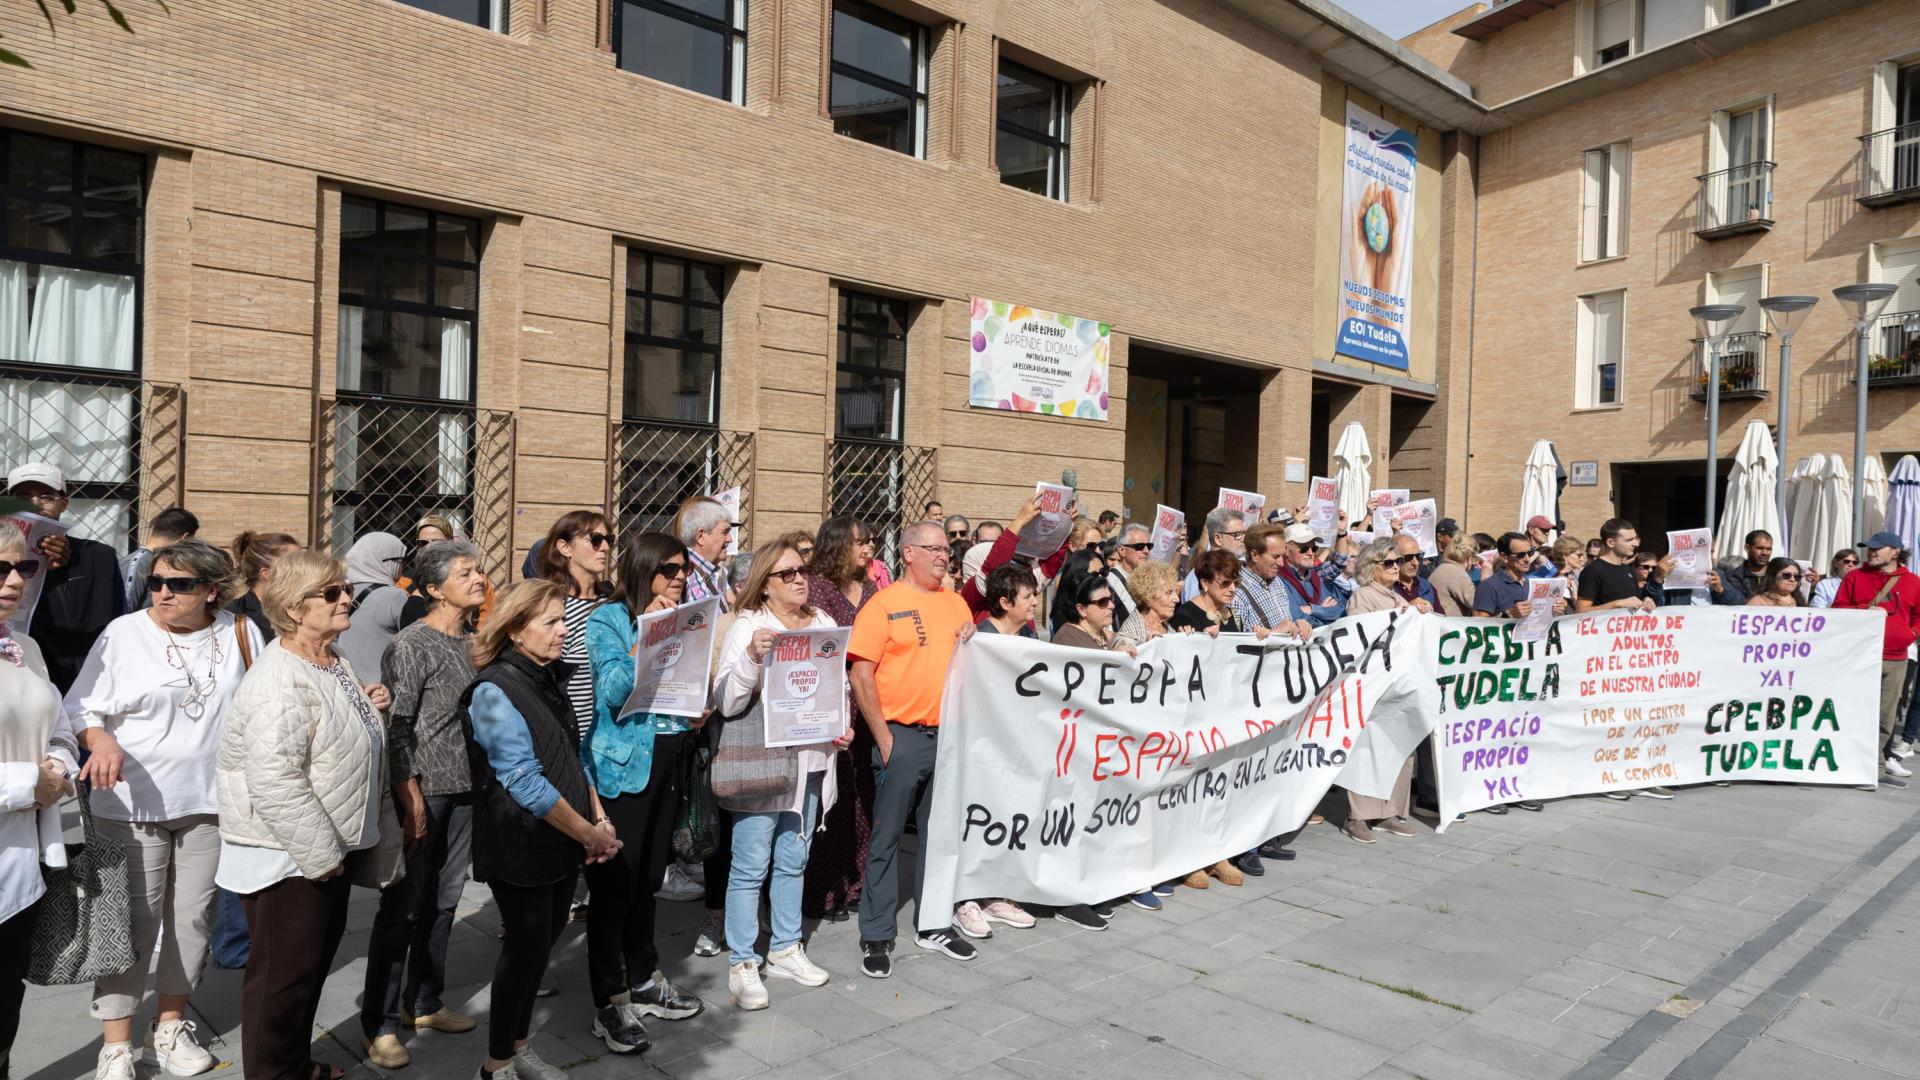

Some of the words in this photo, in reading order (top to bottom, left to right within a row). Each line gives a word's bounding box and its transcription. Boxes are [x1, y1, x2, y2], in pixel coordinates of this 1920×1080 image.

[1344, 280, 1372, 297] NUEVOS
[1372, 288, 1404, 307] IDIOMAS
[1346, 298, 1374, 314] NUEVOS
[1375, 307, 1404, 323] MUNDOS
[1350, 320, 1365, 336] EOI
[1368, 325, 1397, 344] Tudela
[1004, 333, 1042, 351] APRENDE
[1045, 340, 1078, 357] IDIOMAS
[1606, 615, 1658, 634] CENTRO
[1666, 616, 1685, 630] DE
[1731, 612, 1826, 636] ¡ESPACIO
[776, 647, 811, 662] TUDELA
[1586, 656, 1604, 674] EN
[1608, 655, 1623, 671] EL
[1629, 650, 1679, 668] CENTRO
[1742, 640, 1812, 664] PROPIO
[788, 670, 818, 680] ¡ESPACIO
[792, 678, 816, 686] PROPIO
[1580, 680, 1596, 697] DE
[1602, 675, 1654, 694] NUESTRA
[1658, 669, 1701, 689] CIUDAD!
[1760, 670, 1796, 690] YA!
[1436, 662, 1560, 714] TUDELA
[1624, 707, 1642, 722] UN
[1648, 704, 1685, 721] CENTRO
[1704, 694, 1840, 735] CPEBPA
[1445, 711, 1541, 748] ¡ESPACIO
[1607, 726, 1626, 740] DE
[1634, 722, 1680, 738] ADULTOS
[1462, 742, 1529, 772] PROPIO
[1594, 747, 1620, 762] QUE
[1624, 746, 1640, 760] DE
[1647, 744, 1666, 760] VIDA
[1700, 738, 1840, 776] TUDELA
[1602, 771, 1618, 784] AL
[1624, 761, 1678, 781] CENTRO!
[962, 803, 1029, 851] POR
[1040, 803, 1076, 847] UN
[1234, 756, 1252, 789] EN
[1274, 743, 1347, 774] CENTRO
[1484, 776, 1523, 800] YA!
